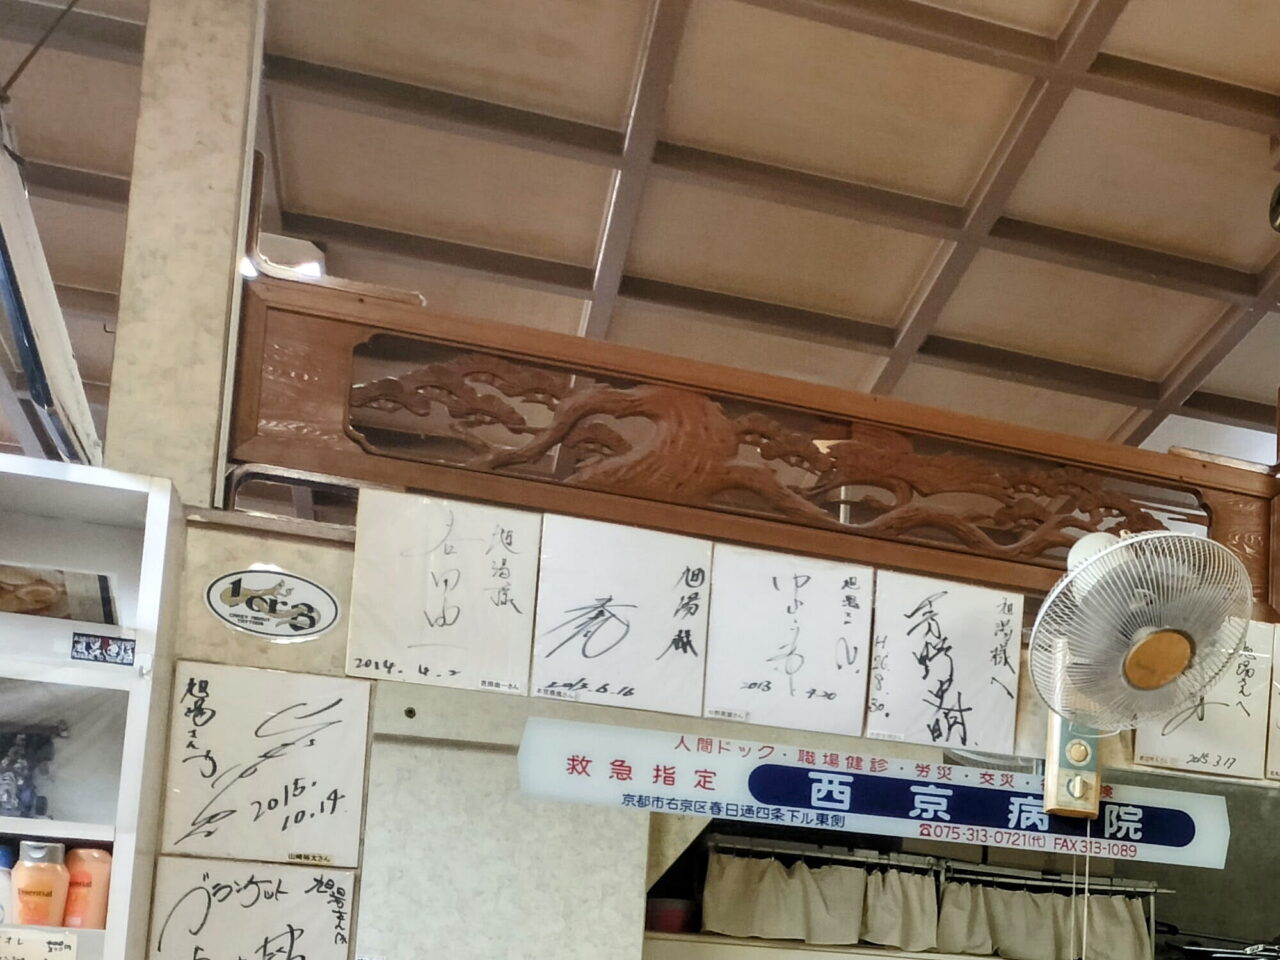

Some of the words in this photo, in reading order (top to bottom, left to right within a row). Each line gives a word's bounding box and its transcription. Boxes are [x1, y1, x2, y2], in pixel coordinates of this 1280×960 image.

[566, 755, 718, 791] 救急指定
[621, 793, 846, 828] 京都市右京区春日通四条下ル東側
[808, 771, 1143, 841] 西京病院
